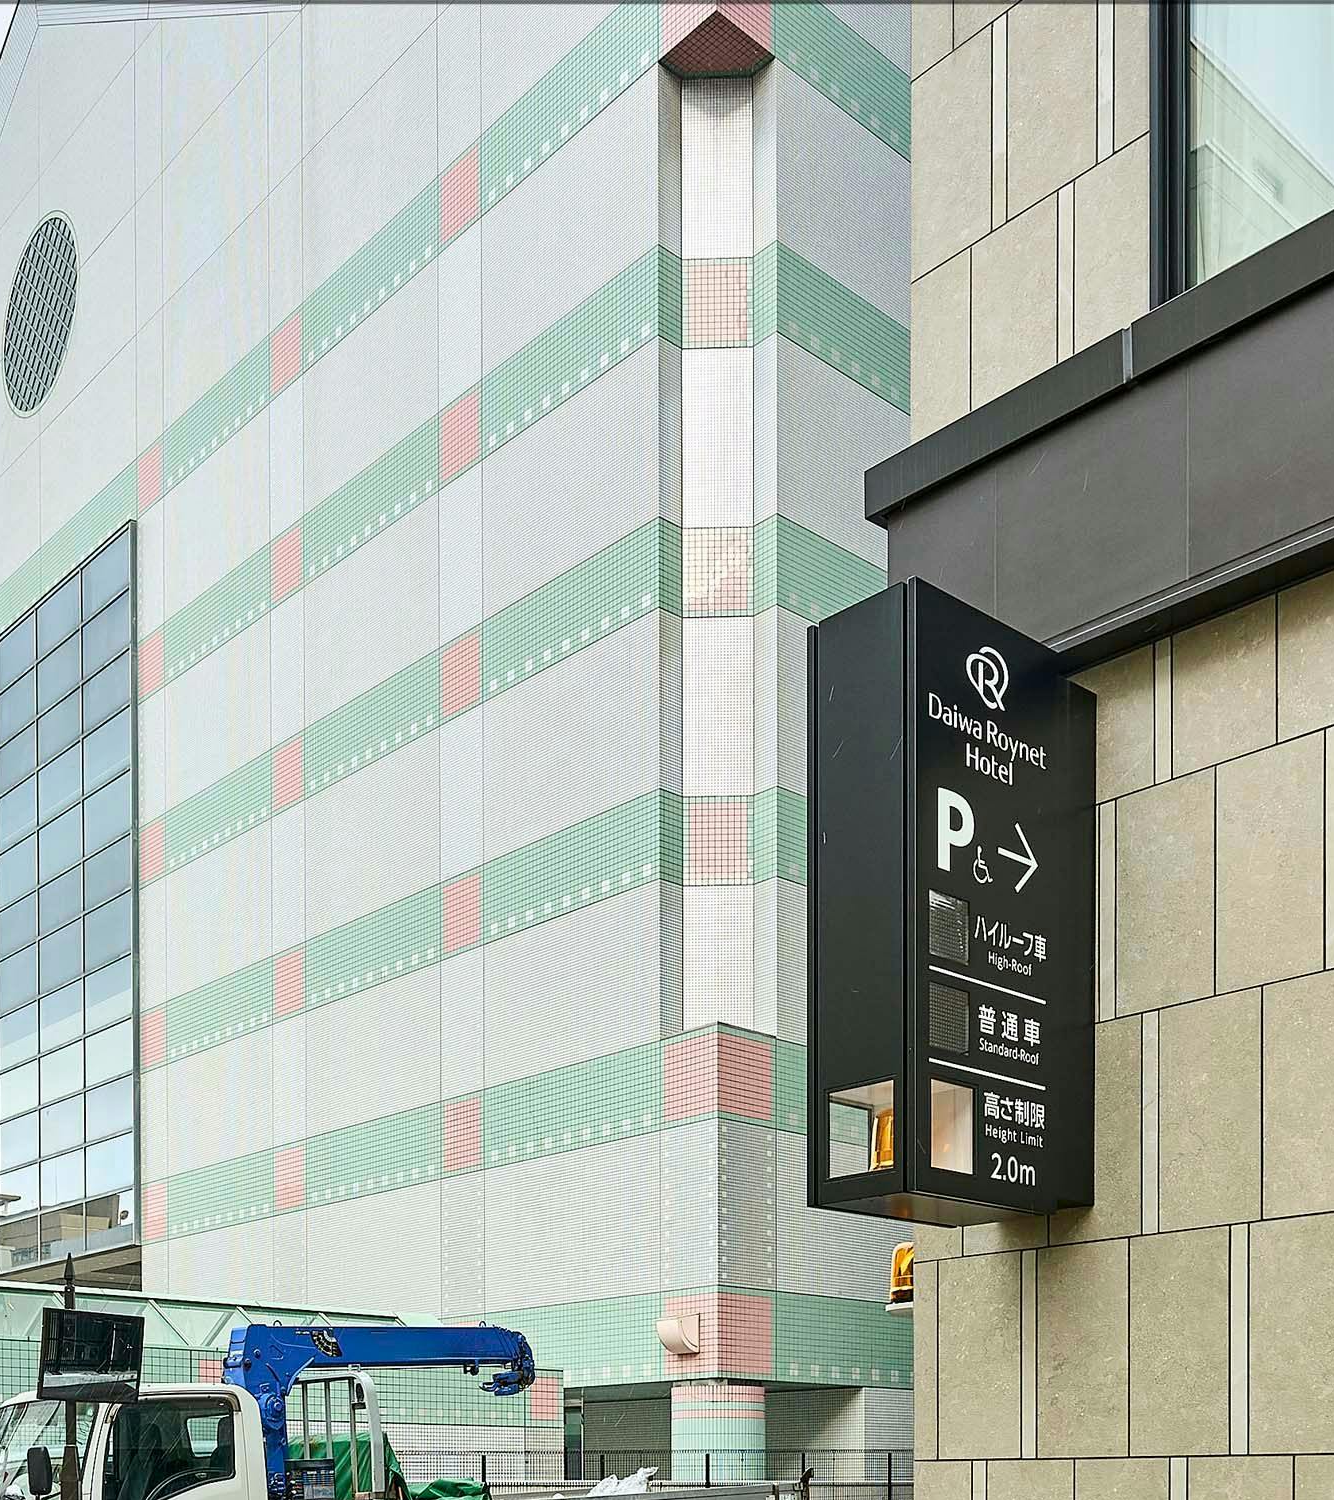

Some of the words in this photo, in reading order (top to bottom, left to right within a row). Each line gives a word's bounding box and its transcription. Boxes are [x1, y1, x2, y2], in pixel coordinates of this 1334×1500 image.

[928, 692, 983, 740] Daiwa
[986, 719, 1047, 770] Roynet
[965, 742, 1014, 787] Hotel
[937, 786, 975, 872] P
[974, 915, 1047, 963] ハイルーフ車
[988, 950, 1033, 977] High-Roof
[977, 1004, 1041, 1047] 普通車
[978, 1037, 1040, 1066] Standard-Roof
[983, 1091, 1045, 1130] 高さ制限
[985, 1123, 1017, 1144] Height
[1020, 1131, 1044, 1148] Limit
[990, 1152, 1036, 1186] 2.0m
